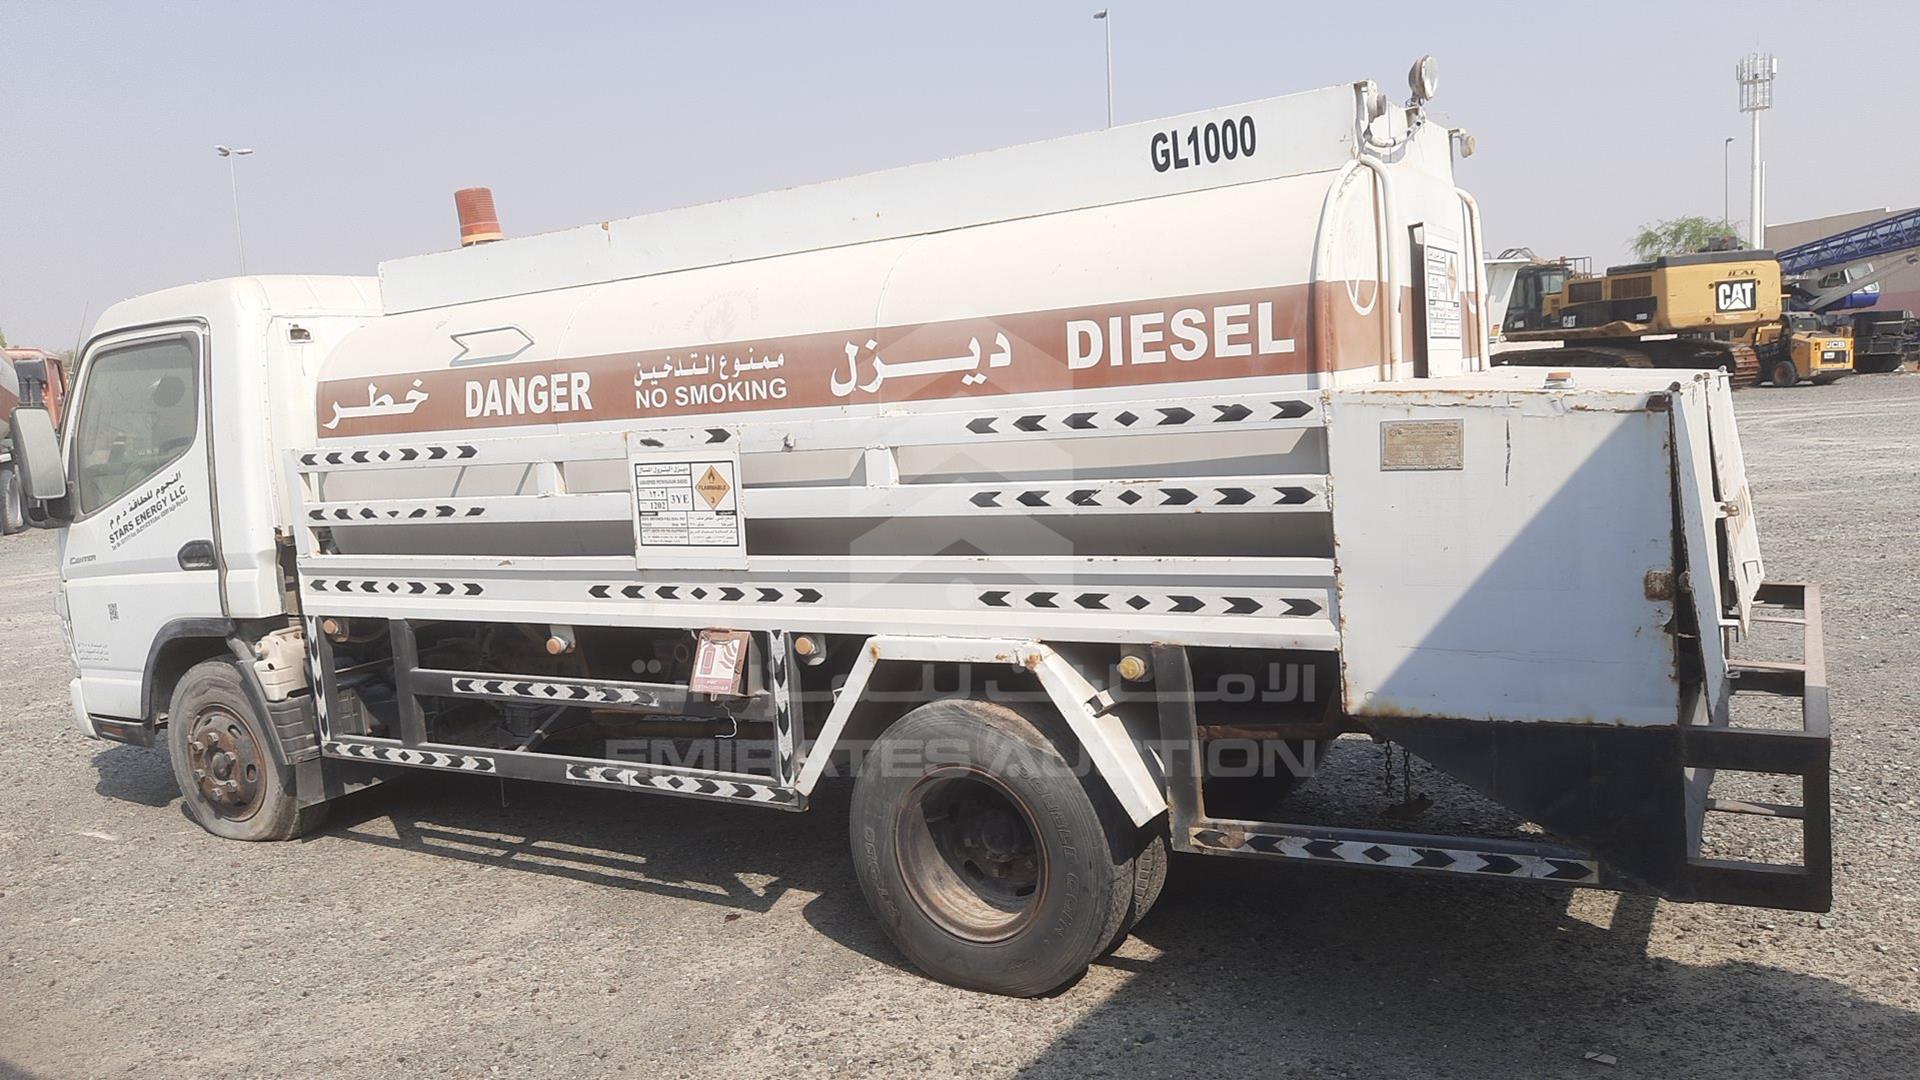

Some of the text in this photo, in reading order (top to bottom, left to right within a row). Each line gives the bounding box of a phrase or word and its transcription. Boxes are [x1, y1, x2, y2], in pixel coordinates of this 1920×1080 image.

[1151, 114, 1257, 173] GL1000
[1718, 281, 1754, 311] CAT
[1066, 300, 1295, 371] DIESEL
[1562, 315, 1577, 328] CAT
[830, 330, 1012, 398] ديزل
[1825, 340, 1846, 349] JCB
[633, 346, 785, 388] ممنوع التدخين
[321, 377, 430, 431] خطر
[465, 371, 593, 419] DANGER
[635, 376, 788, 410] NO SMOKING
[108, 520, 135, 545] STARS
[134, 495, 168, 527] ENERGY
[169, 484, 187, 502] LLC
[650, 502, 666, 510] 1202
[670, 494, 690, 504] 3YE
